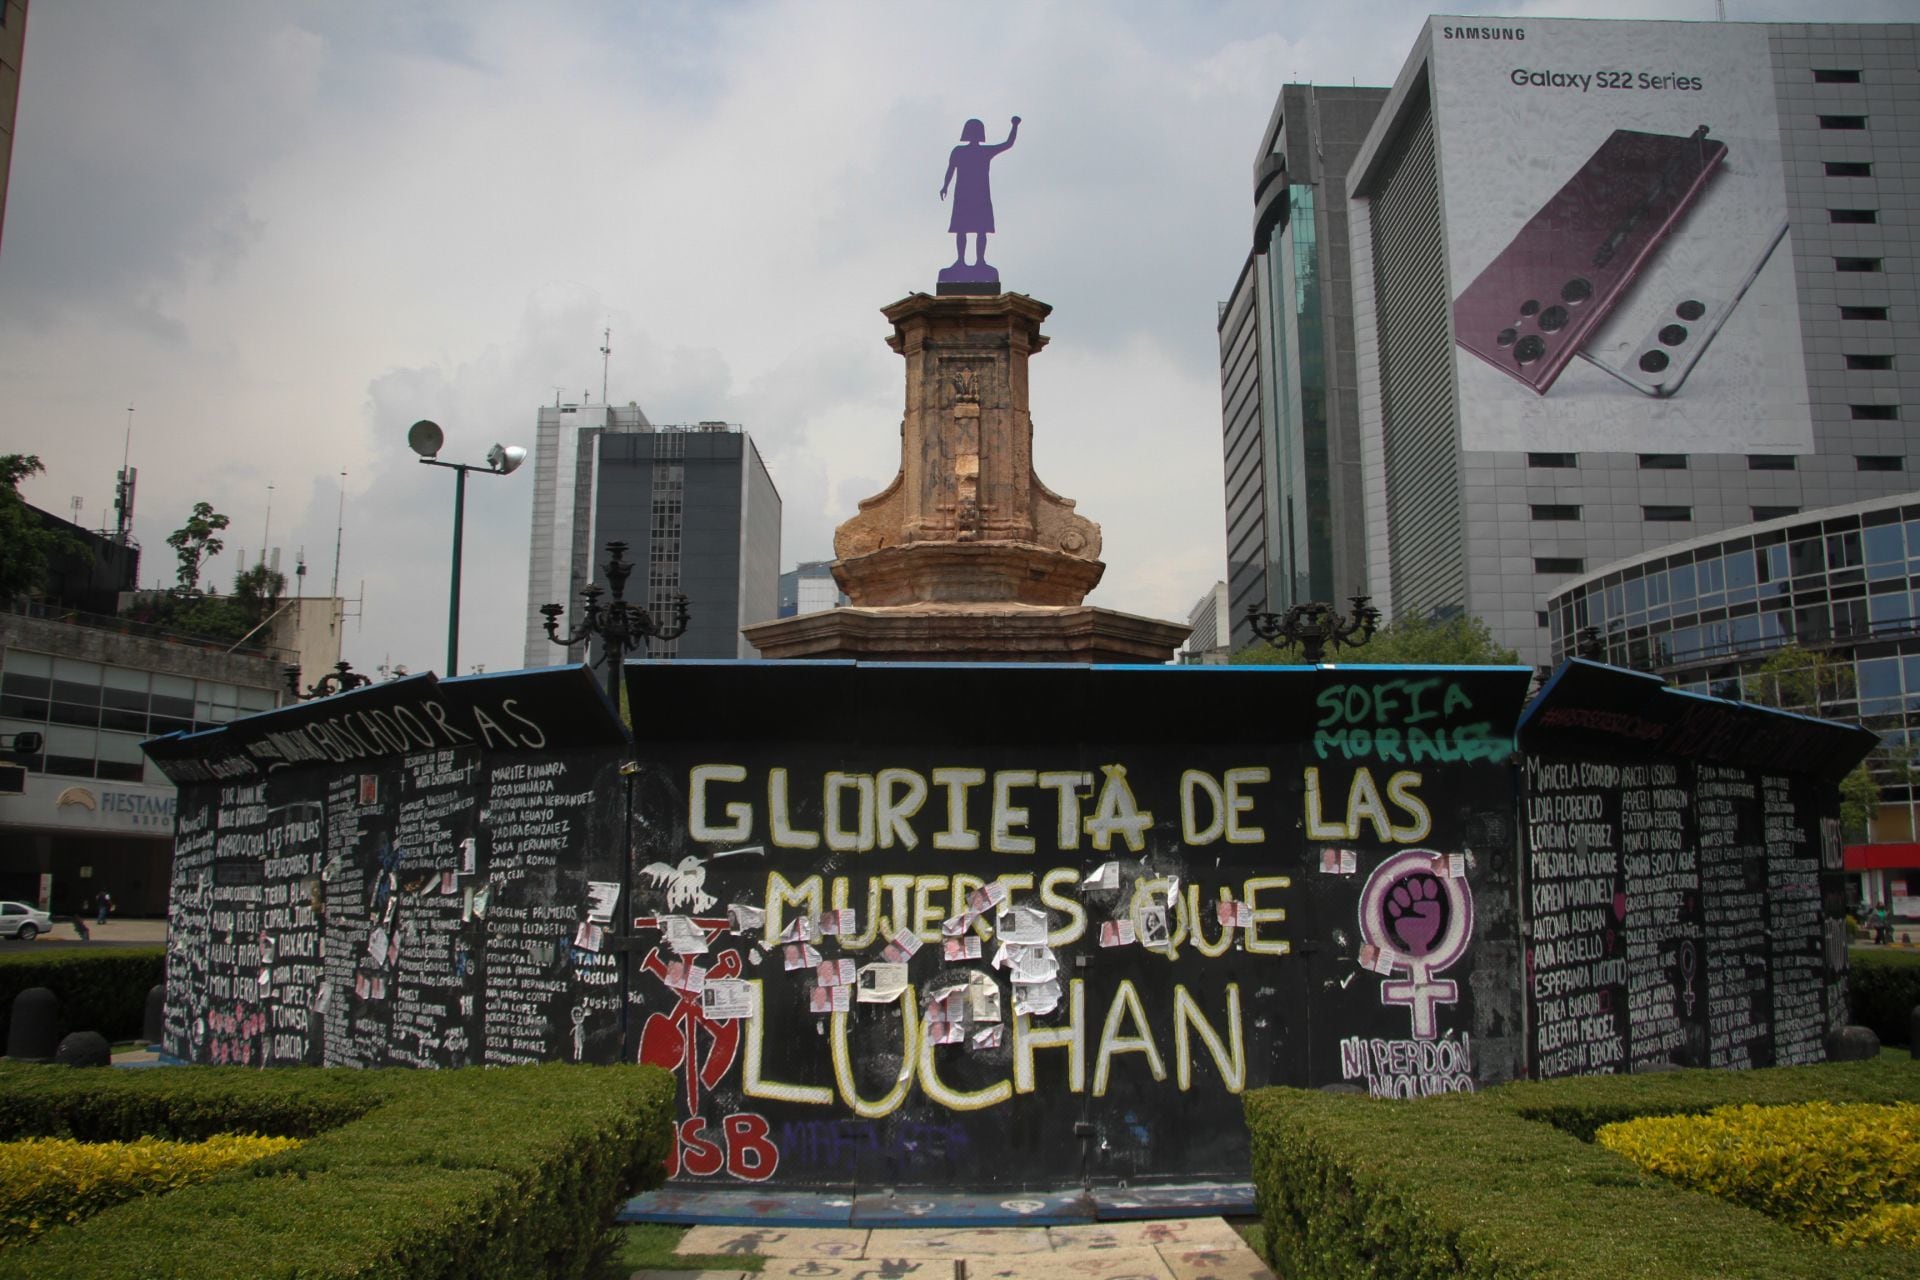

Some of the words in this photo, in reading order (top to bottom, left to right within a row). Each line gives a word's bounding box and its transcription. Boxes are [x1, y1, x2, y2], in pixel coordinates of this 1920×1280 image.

[1443, 26, 1526, 41] SAMSUNG
[1510, 68, 1592, 93] Galaxy
[1596, 70, 1633, 91] S22
[1637, 72, 1703, 91] Series
[1315, 678, 1473, 727] SOFIA
[490, 783, 512, 798] ROSA
[689, 763, 1153, 854] GLORIETA
[1180, 766, 1272, 845] DE
[1303, 766, 1433, 844] LAS
[1527, 796, 1554, 824] LIDIA
[1554, 794, 1603, 823] FLORENCIO
[491, 824, 523, 841] YADIRA
[1529, 824, 1568, 851] LORENA
[492, 841, 515, 856] SARA
[526, 854, 558, 867] ROMAN
[1532, 852, 1588, 879] MAGDALENA
[1651, 853, 1673, 875] SOTO
[489, 871, 505, 884] EVA
[1532, 882, 1565, 917] KAREN
[1565, 877, 1615, 907] MARTINELY
[532, 905, 578, 921] PALMEROS
[764, 867, 1087, 950] MUJERES
[1130, 874, 1291, 961] QUE
[1533, 914, 1571, 942] ANTONIA
[1571, 908, 1606, 934] ALEMAN
[521, 921, 567, 936] ELIZABETH
[1626, 929, 1646, 944] DULCE
[278, 931, 315, 958] OAXACA
[1534, 942, 1557, 970] ALVA
[575, 953, 617, 968] TANIA
[573, 969, 619, 987] YOSELIN
[1534, 965, 1591, 1000] ESPERANZA
[271, 1004, 309, 1033] TOMASA
[511, 1002, 538, 1016] LOPEZ
[485, 1037, 509, 1049] ISELA
[510, 1025, 542, 1038] ESLAVA
[1538, 1017, 1579, 1054] ALBERTA
[743, 975, 1245, 1119] LUCHAN
[1340, 1036, 1370, 1080] NI
[1369, 1028, 1472, 1078] PERDÓN
[1540, 1043, 1588, 1079] MONSERRAT
